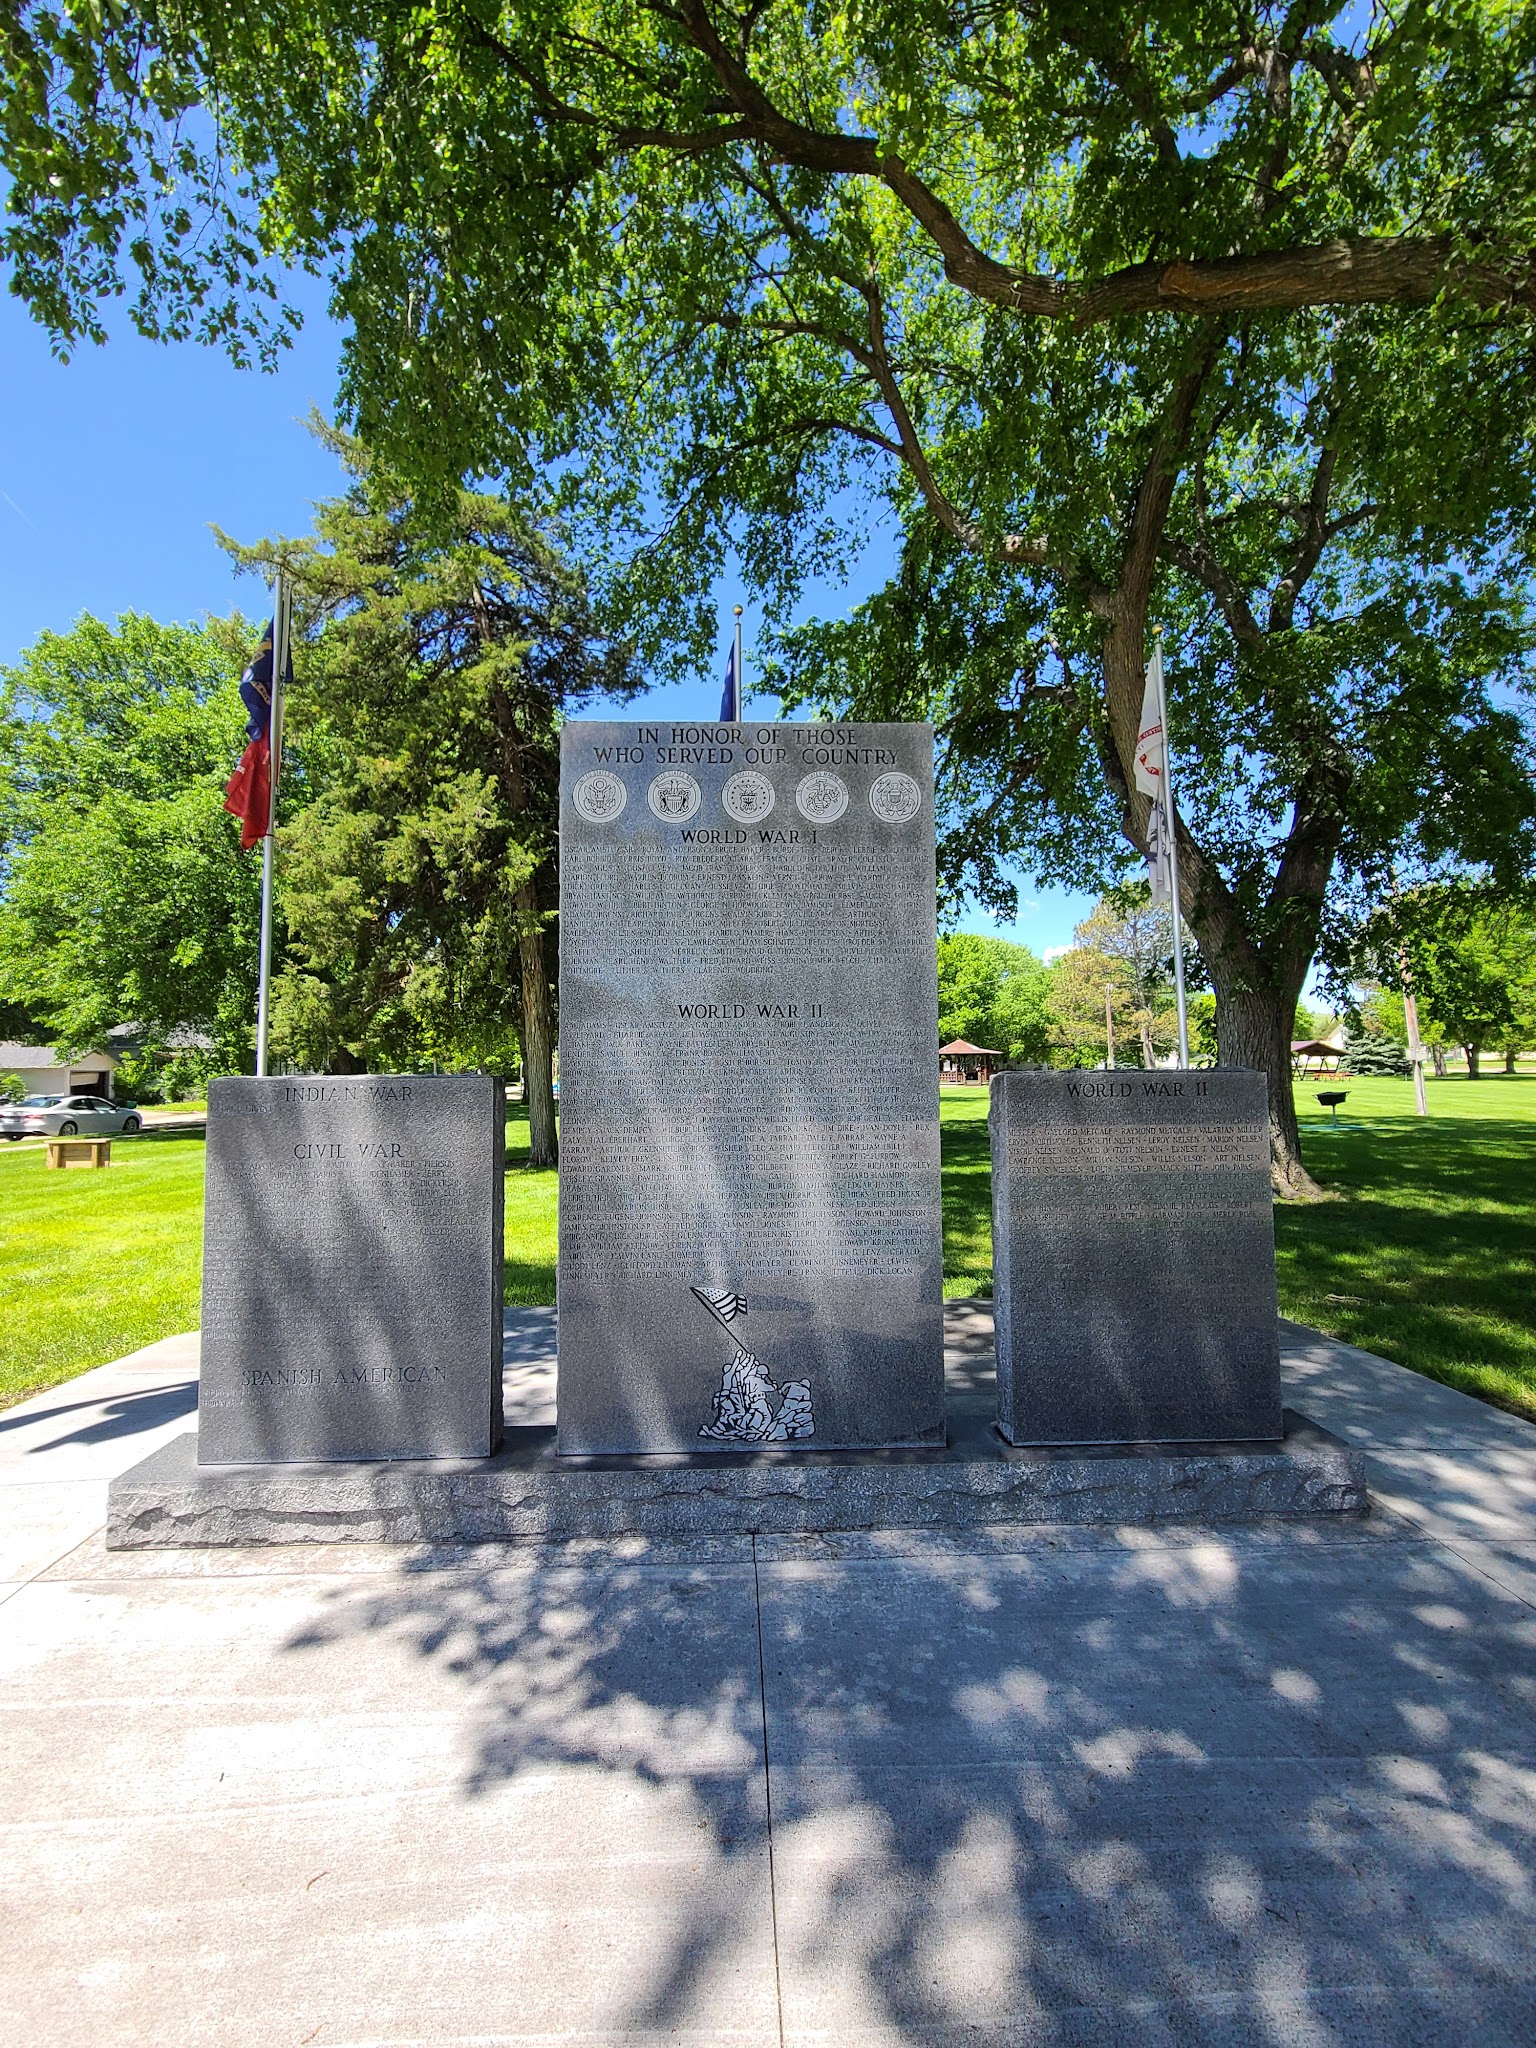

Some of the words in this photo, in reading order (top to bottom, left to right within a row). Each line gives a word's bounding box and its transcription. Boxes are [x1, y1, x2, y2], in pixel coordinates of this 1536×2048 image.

[637, 728, 659, 744] IN
[671, 728, 744, 744] HONOR
[757, 729, 782, 744] OF
[793, 729, 857, 744] THOSE
[594, 747, 645, 763] WHO
[656, 747, 732, 763] SERVED
[745, 748, 791, 764] OUR
[802, 748, 897, 764] COUNTRY
[681, 829, 746, 844] WORLD
[758, 829, 799, 844] WAR
[811, 829, 816, 844] I
[679, 1004, 745, 1020] WORLD
[757, 1004, 799, 1020] WAR
[812, 1004, 824, 1019] II
[285, 1086, 357, 1102] INDIAN
[369, 1086, 414, 1101] WAR
[1066, 1083, 1132, 1098] WORLD
[1142, 1082, 1185, 1097] WAR
[1196, 1082, 1207, 1096] II
[294, 1143, 346, 1159] CIVIL
[358, 1143, 404, 1158] WAR
[241, 1369, 322, 1386] SPANISH
[333, 1365, 448, 1384] AMERICAN
